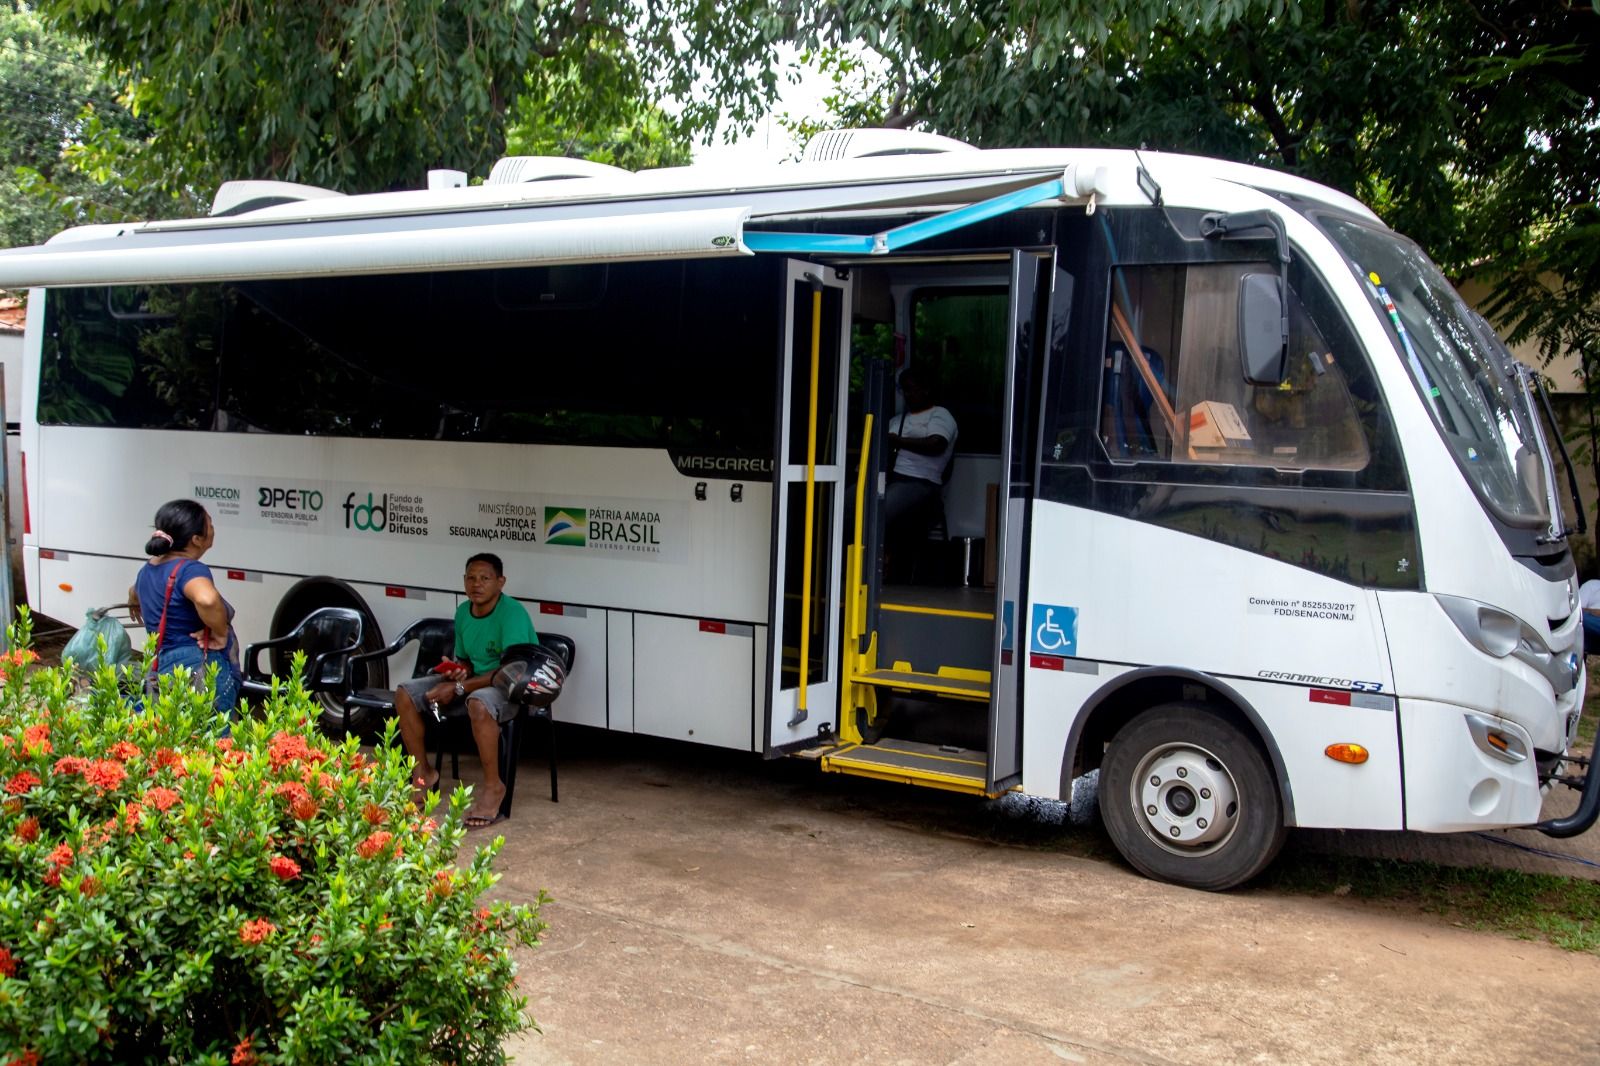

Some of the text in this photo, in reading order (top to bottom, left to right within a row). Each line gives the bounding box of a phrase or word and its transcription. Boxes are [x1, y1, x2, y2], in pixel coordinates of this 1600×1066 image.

[195, 486, 240, 499] NUDECON
[390, 494, 422, 504] Fundo de
[343, 492, 387, 532] fdd
[390, 502, 424, 513] Defesa de
[478, 502, 536, 516] MINISTÉRIO DA
[261, 510, 294, 520] DEFENSORIA
[390, 512, 428, 524] Direitos
[590, 507, 660, 524] PÁTRIA AMADA
[389, 522, 428, 536] Difusos
[496, 517, 536, 530] JUSTIÇA E
[450, 526, 536, 542] SEGURANÇA PÚBLICA
[590, 521, 660, 544] BRASIL
[589, 542, 660, 553] GOVERNO FEDERAL
[1249, 597, 1289, 606] Convênio
[1302, 600, 1354, 611] 852553/2017
[1274, 608, 1354, 620] FDD/SENACON/MJ
